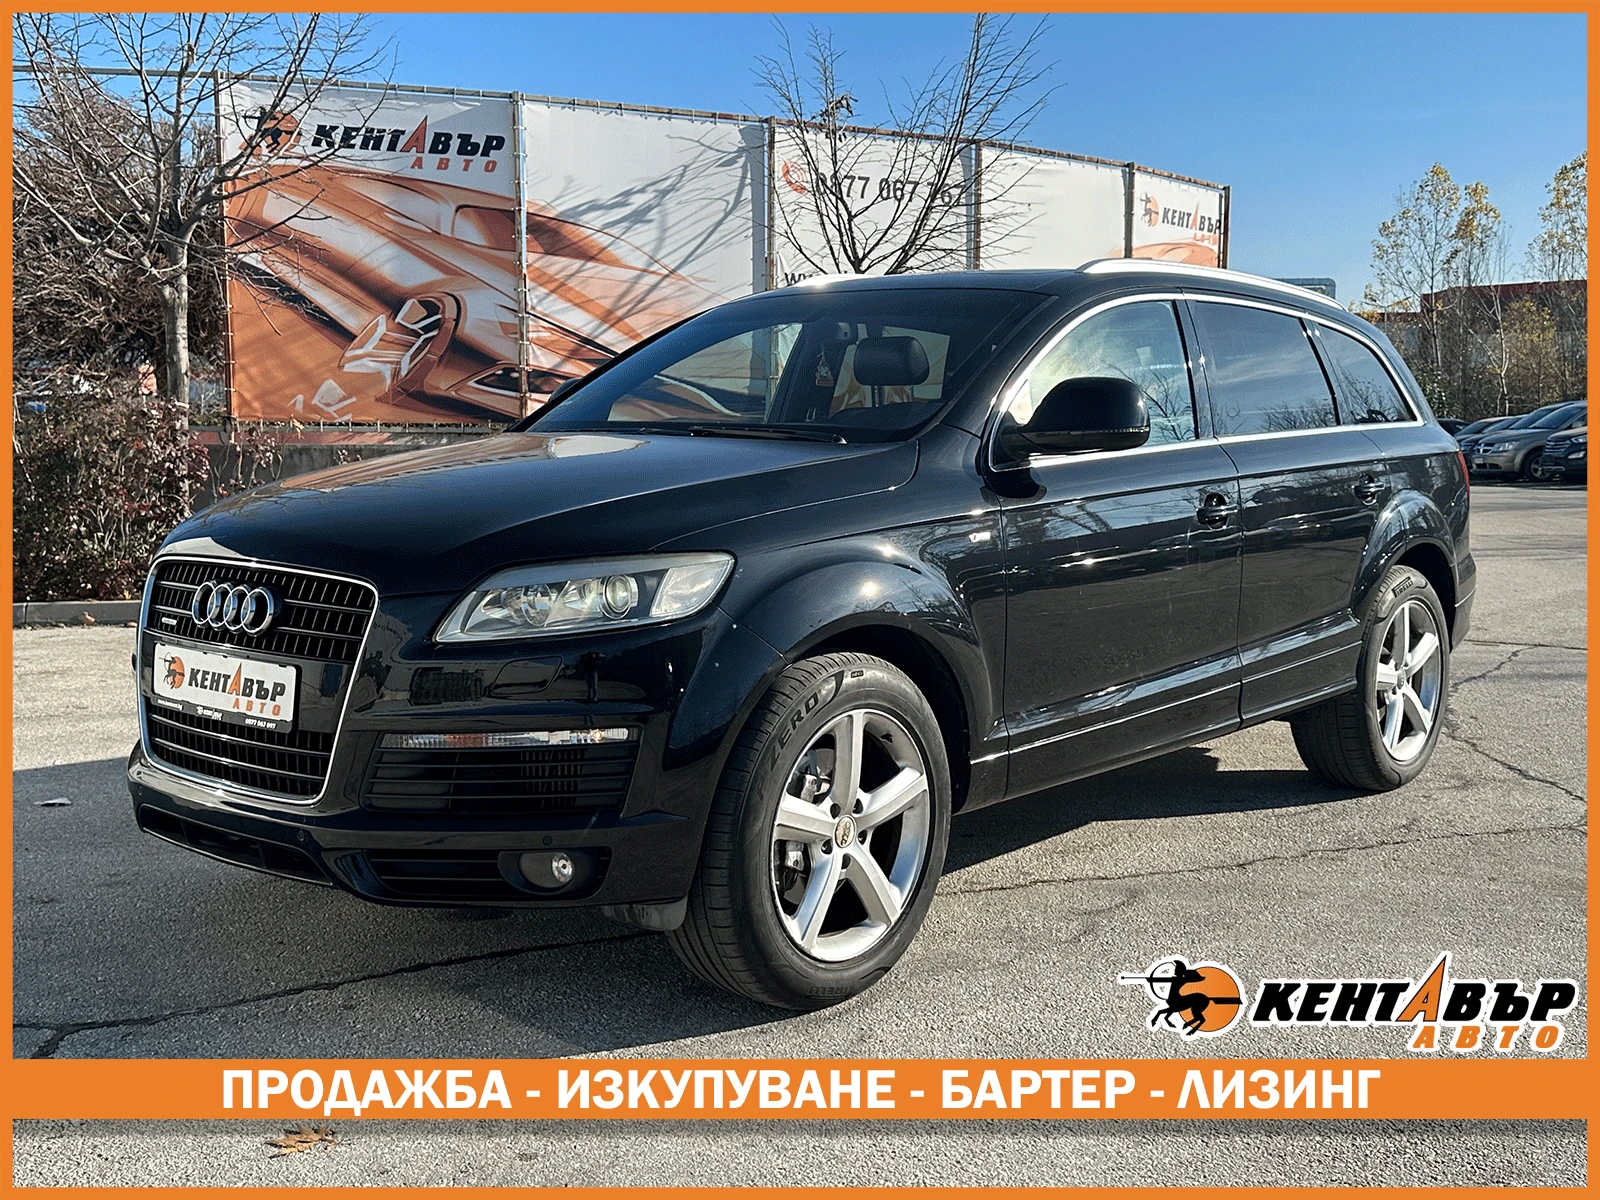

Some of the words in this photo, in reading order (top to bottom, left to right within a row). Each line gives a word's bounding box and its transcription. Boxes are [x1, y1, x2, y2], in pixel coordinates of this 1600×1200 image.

[311, 115, 506, 158] КЕНТАВЪР
[410, 156, 498, 173] АВТО
[879, 178, 919, 202] 067
[1161, 203, 1221, 235] КЕНТАВЪР
[187, 662, 286, 702] КЕНТАВЪР
[232, 698, 282, 717] АВТО
[766, 692, 819, 773] ZERO
